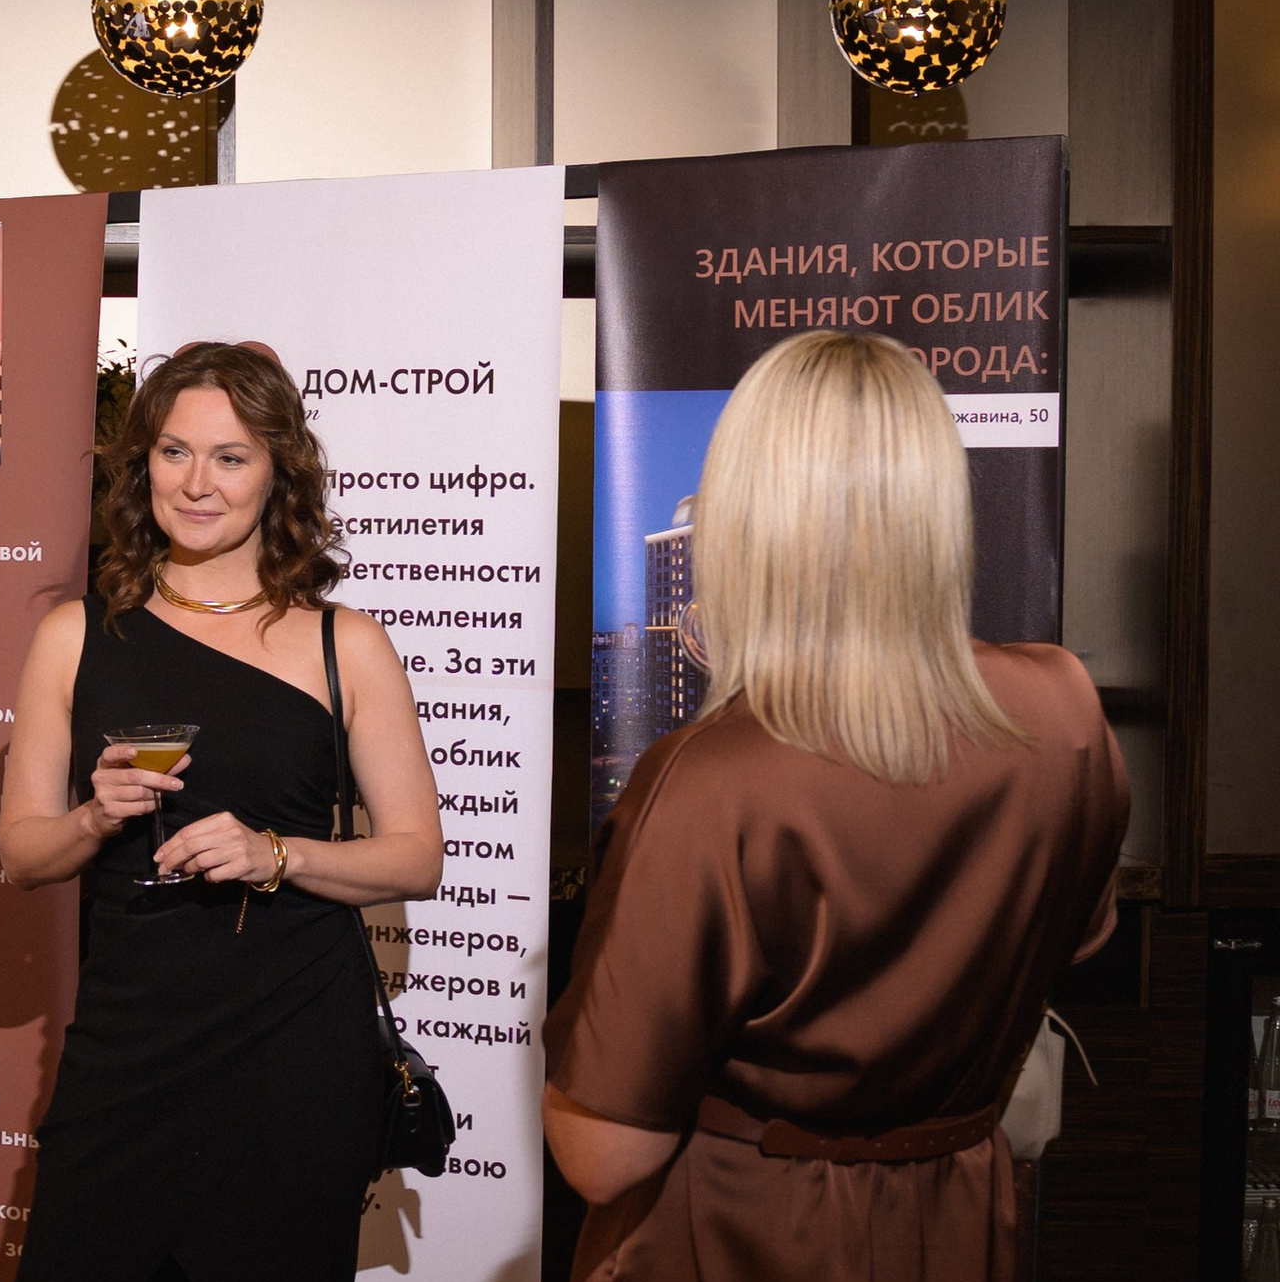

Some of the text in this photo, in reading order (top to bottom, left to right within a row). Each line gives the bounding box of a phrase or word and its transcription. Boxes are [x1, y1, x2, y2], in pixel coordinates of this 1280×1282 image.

[695, 236, 1049, 285] ЗДАНИЯ, КОТОРЫЕ
[735, 290, 1049, 328] МЕНЯЮТ ОБЛИК
[302, 361, 495, 400] ДОМ-СТРОЙ
[1029, 408, 1049, 422] 50
[429, 464, 535, 498] цифра.
[444, 648, 481, 674] За
[491, 657, 535, 676] эти
[430, 739, 521, 768] облик
[432, 885, 496, 908] нды
[510, 981, 526, 999] и
[417, 1021, 531, 1047] каждый
[443, 1156, 507, 1179] вою
